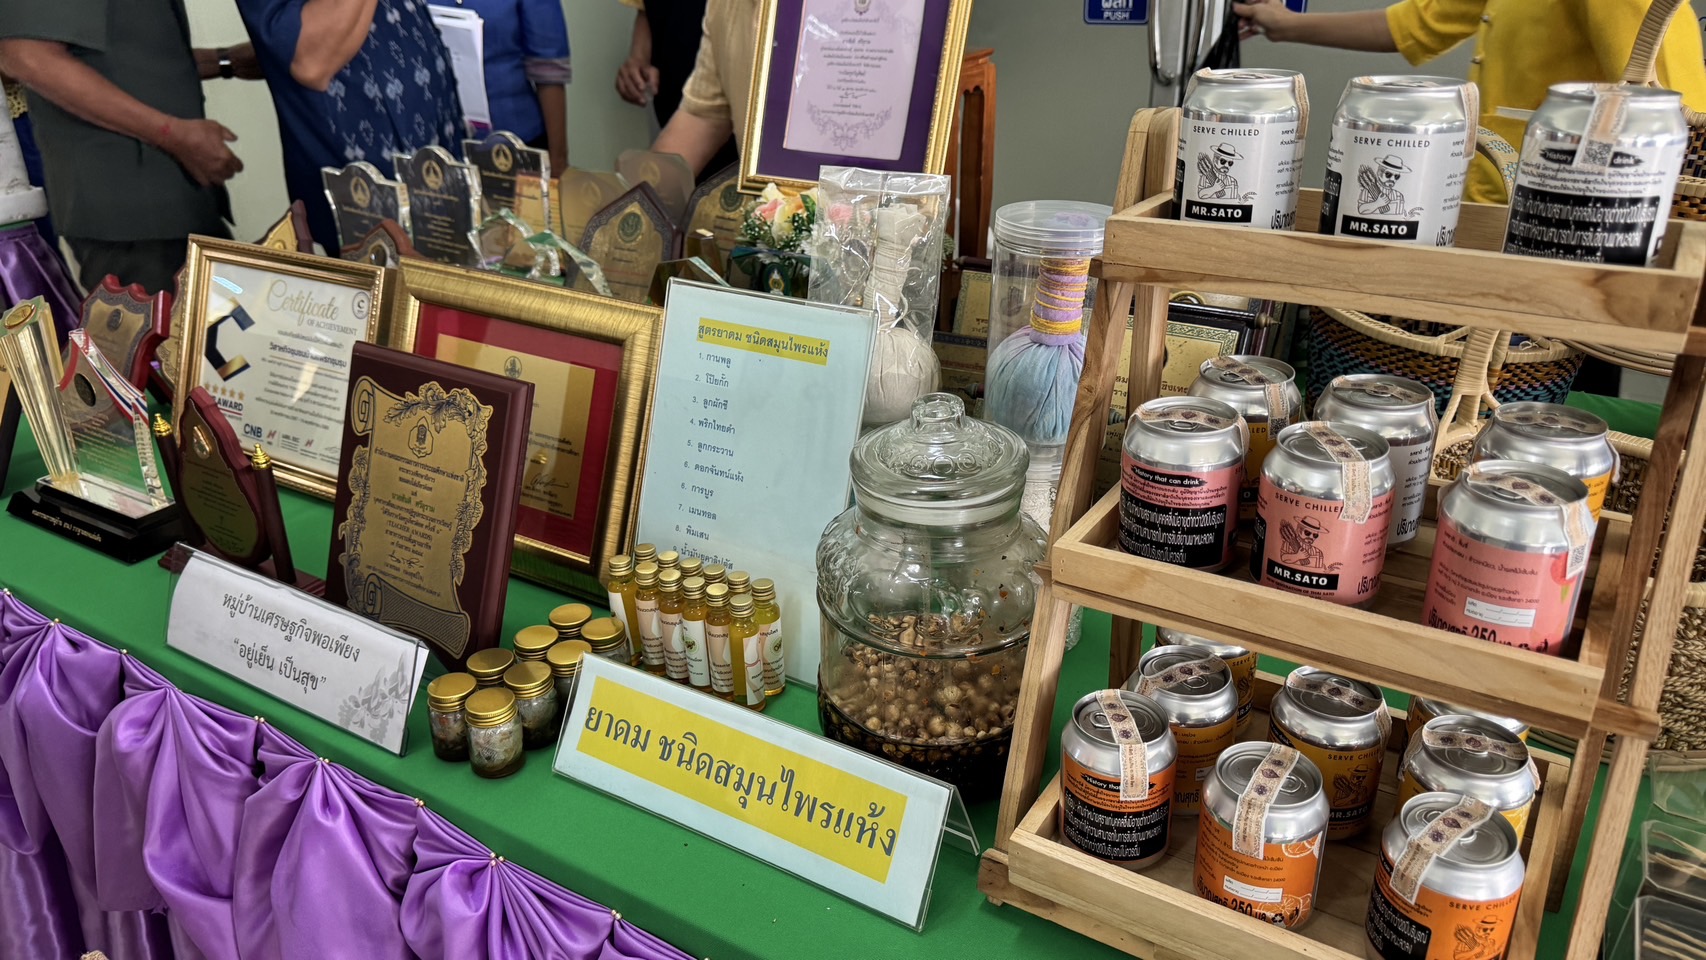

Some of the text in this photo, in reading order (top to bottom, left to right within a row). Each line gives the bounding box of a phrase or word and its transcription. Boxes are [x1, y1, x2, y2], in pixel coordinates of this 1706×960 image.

[1103, 11, 1131, 21] PUSH
[1193, 125, 1260, 137] SERVE CHILLED
[1353, 135, 1431, 148] SERVE CHILLED
[1191, 205, 1243, 219] MR.SATO
[1349, 221, 1408, 236] MR.SATO
[266, 279, 339, 327] Certificate
[306, 317, 358, 337] OF ACHIEVEMENT
[697, 323, 829, 359] สูตรยาดม ชนิดสมุนไพรแห้ง
[705, 352, 732, 369] กานพลู
[217, 397, 244, 412] AWARD
[702, 396, 729, 411] ลูกผักชี
[243, 422, 263, 438] CNB
[697, 417, 736, 436] พริกไทยดำ
[697, 440, 735, 458] ลูกกระวาน
[1155, 474, 1167, 483] that
[1169, 477, 1181, 485] can
[691, 482, 715, 500] การบูร
[1274, 491, 1300, 507] SERVE
[688, 504, 718, 521] เมนทอล
[685, 524, 710, 541] พิมเสน
[1273, 565, 1328, 587] MR.SATO
[221, 591, 361, 663] หมู่บ้านเศรษฐกิจพอเพียง
[1471, 625, 1497, 643] 250
[1327, 753, 1355, 761] SERVE
[584, 704, 898, 857] ยาดม ชนิดสมุนไพรแห้ง
[1230, 897, 1253, 917] 250
[1449, 900, 1481, 912] SERVE
